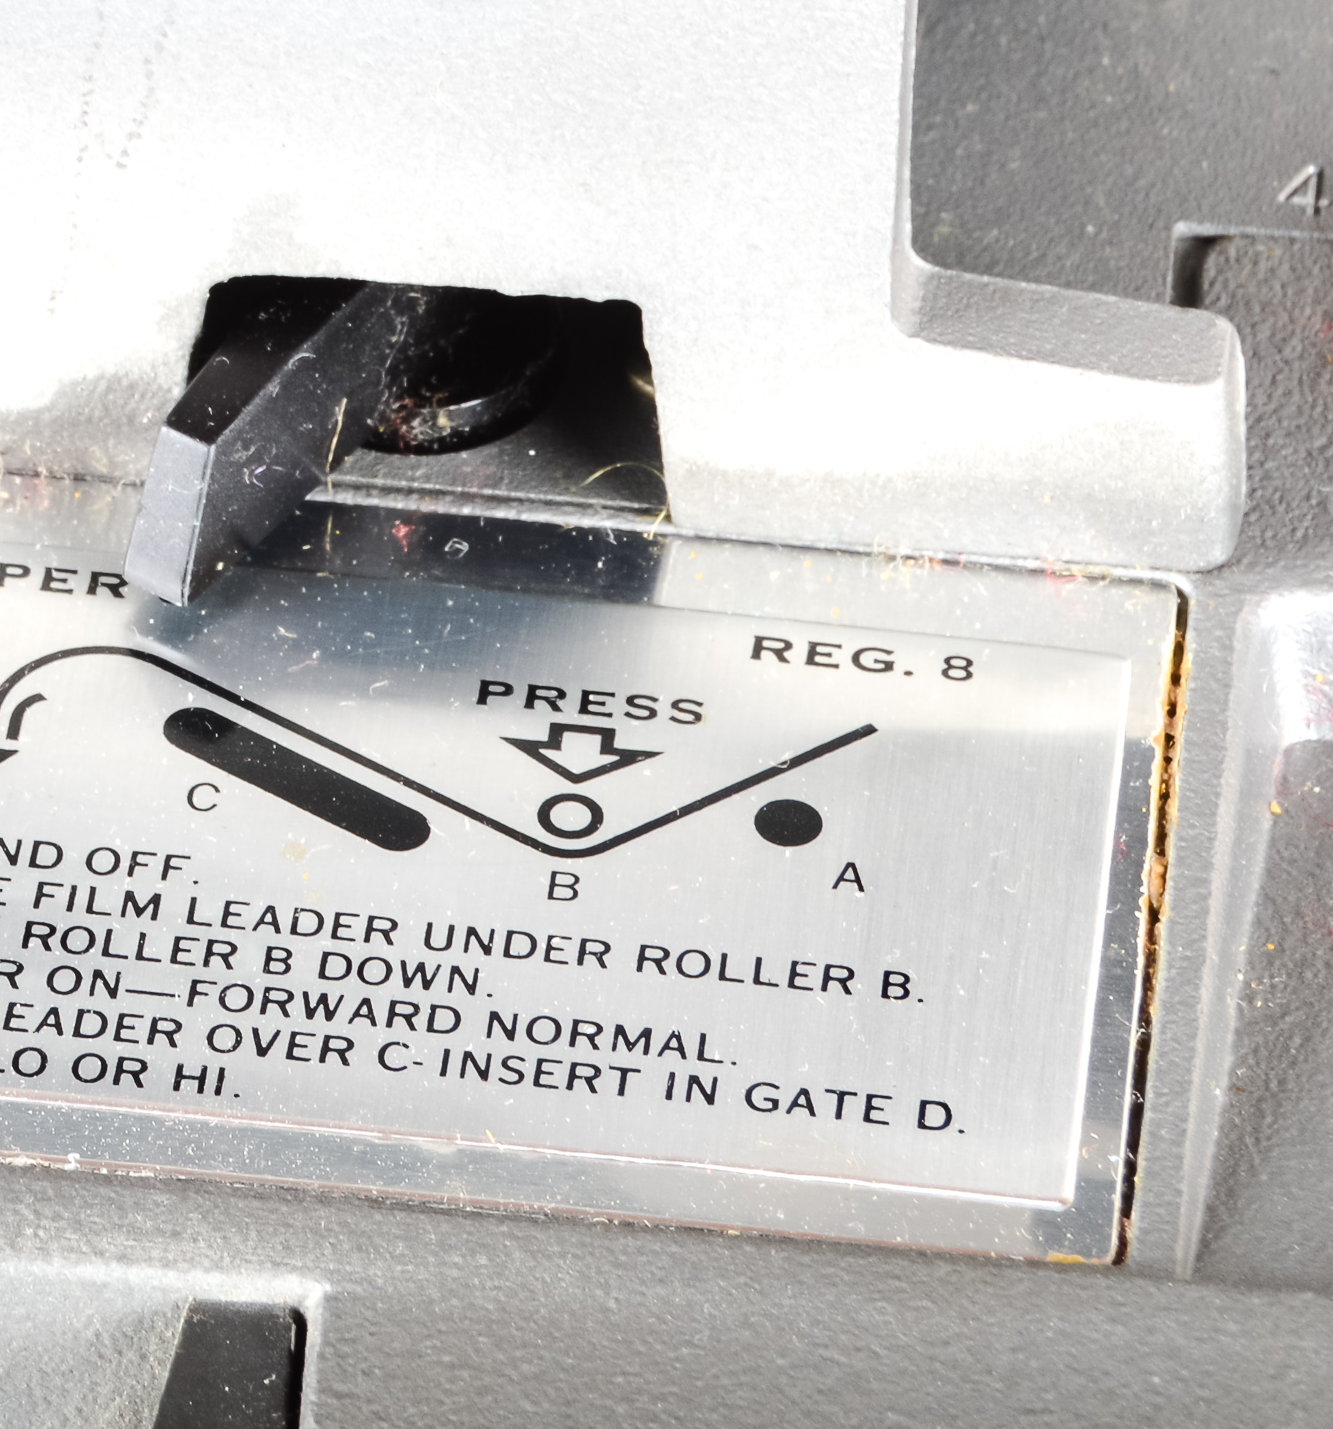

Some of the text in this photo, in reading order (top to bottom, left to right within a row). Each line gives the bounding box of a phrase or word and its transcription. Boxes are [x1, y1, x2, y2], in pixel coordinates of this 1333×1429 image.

[749, 635, 973, 681] REG. 8
[476, 679, 706, 725] PRESS
[187, 783, 220, 811] C
[85, 847, 200, 884] OFF.
[548, 871, 580, 901] B
[832, 862, 864, 892] A
[22, 920, 238, 971] ROLLER
[262, 946, 293, 976] B
[317, 951, 493, 998] DOWN.
[33, 881, 162, 922] FILM
[186, 896, 399, 946] LEADER
[424, 921, 612, 969] UNDER
[636, 944, 855, 995] ROLLER
[880, 970, 925, 1003] B.
[486, 1010, 737, 1066] NORMAL.
[71, 1052, 149, 1089] OR
[172, 1063, 241, 1099] HI.
[206, 1023, 355, 1067] OVER
[665, 1071, 719, 1106] IN
[744, 1081, 893, 1126] GATE
[917, 1099, 966, 1134] D.
